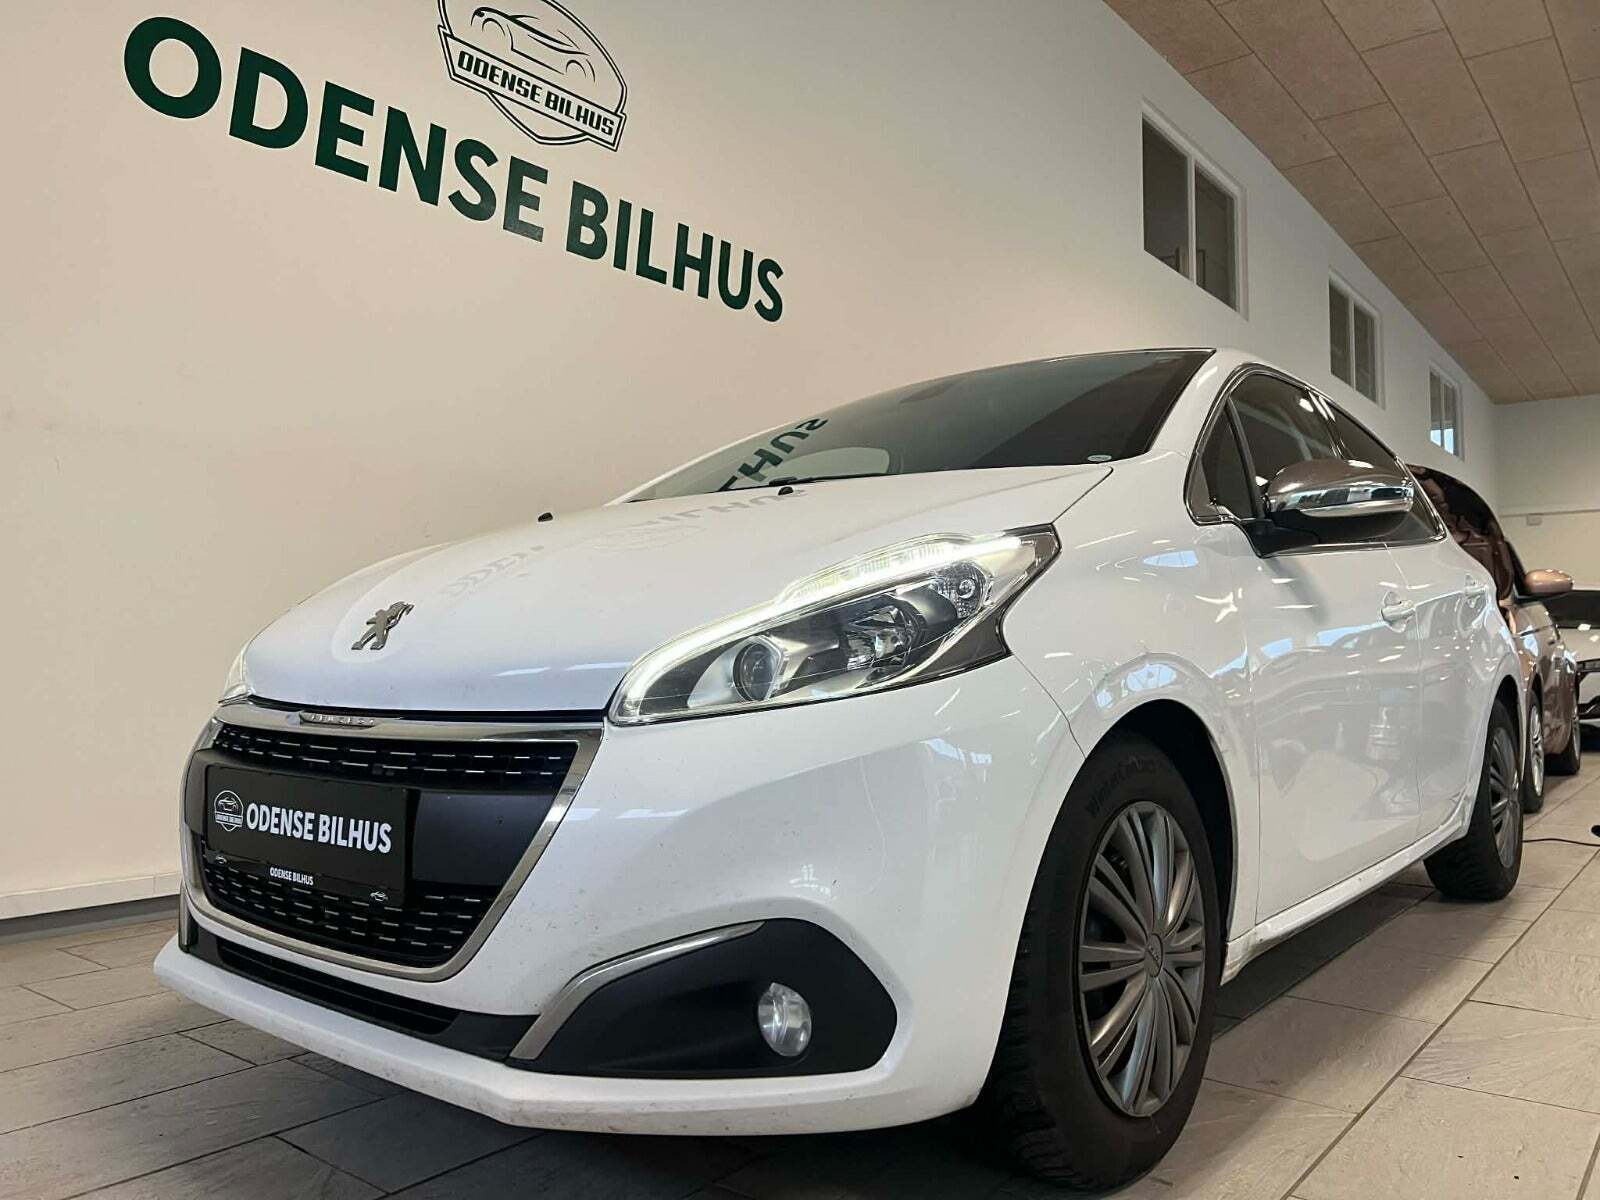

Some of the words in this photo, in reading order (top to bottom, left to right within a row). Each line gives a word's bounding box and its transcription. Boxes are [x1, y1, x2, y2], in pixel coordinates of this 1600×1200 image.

[457, 50, 543, 104] ODENSE
[544, 90, 615, 137] BILHUS
[124, 16, 548, 243] ODENSE
[566, 180, 784, 323] BILHUS
[246, 803, 314, 841] ODENSE
[318, 814, 392, 853] BILHUS
[269, 866, 292, 881] ODENSE
[292, 872, 314, 886] BILHUS
